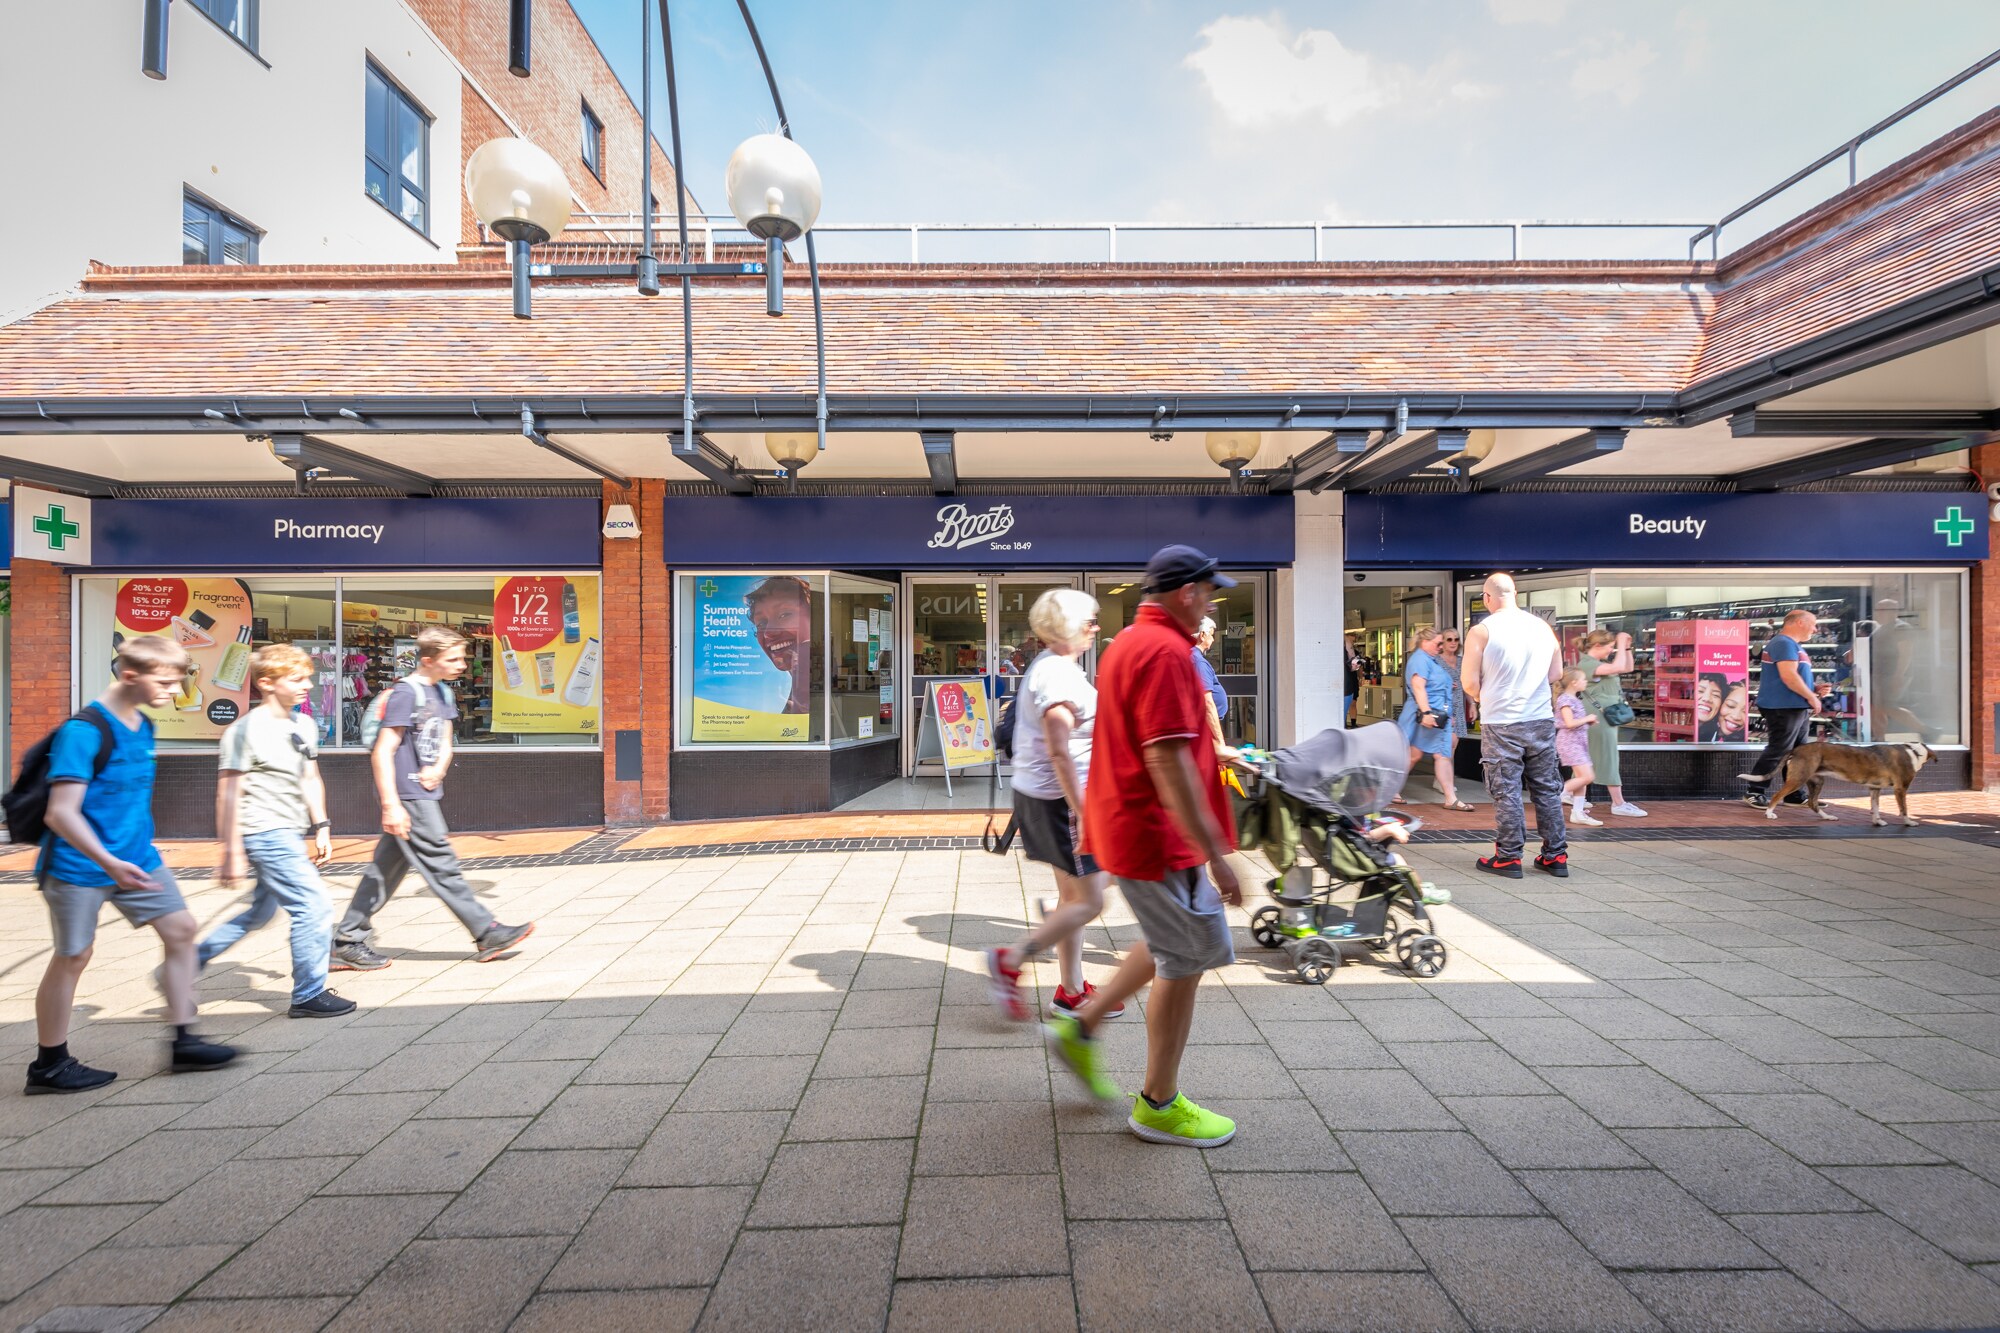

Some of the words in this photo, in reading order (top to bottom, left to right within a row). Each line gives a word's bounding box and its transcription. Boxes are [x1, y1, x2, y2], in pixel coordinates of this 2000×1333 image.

[743, 263, 763, 273] 26
[607, 521, 634, 529] SECOM
[927, 503, 1015, 550] Boots
[1629, 513, 1707, 539] Beauty
[274, 519, 384, 544] Pharmacy
[990, 541, 1012, 550] Since
[1013, 541, 1032, 550] 1849
[132, 584, 152, 592] 20%
[154, 585, 174, 593] OFF
[132, 596, 150, 604] 15%
[193, 591, 245, 604] Fragrance
[512, 593, 549, 616] 1/2
[703, 604, 750, 615] Summer
[131, 609, 149, 617] 10%
[512, 616, 549, 625] PRICE
[703, 615, 741, 626] Health
[703, 626, 748, 637] Services
[1661, 626, 1689, 638] benefit
[1704, 625, 1740, 638] benefit
[942, 694, 959, 706] 1/2
